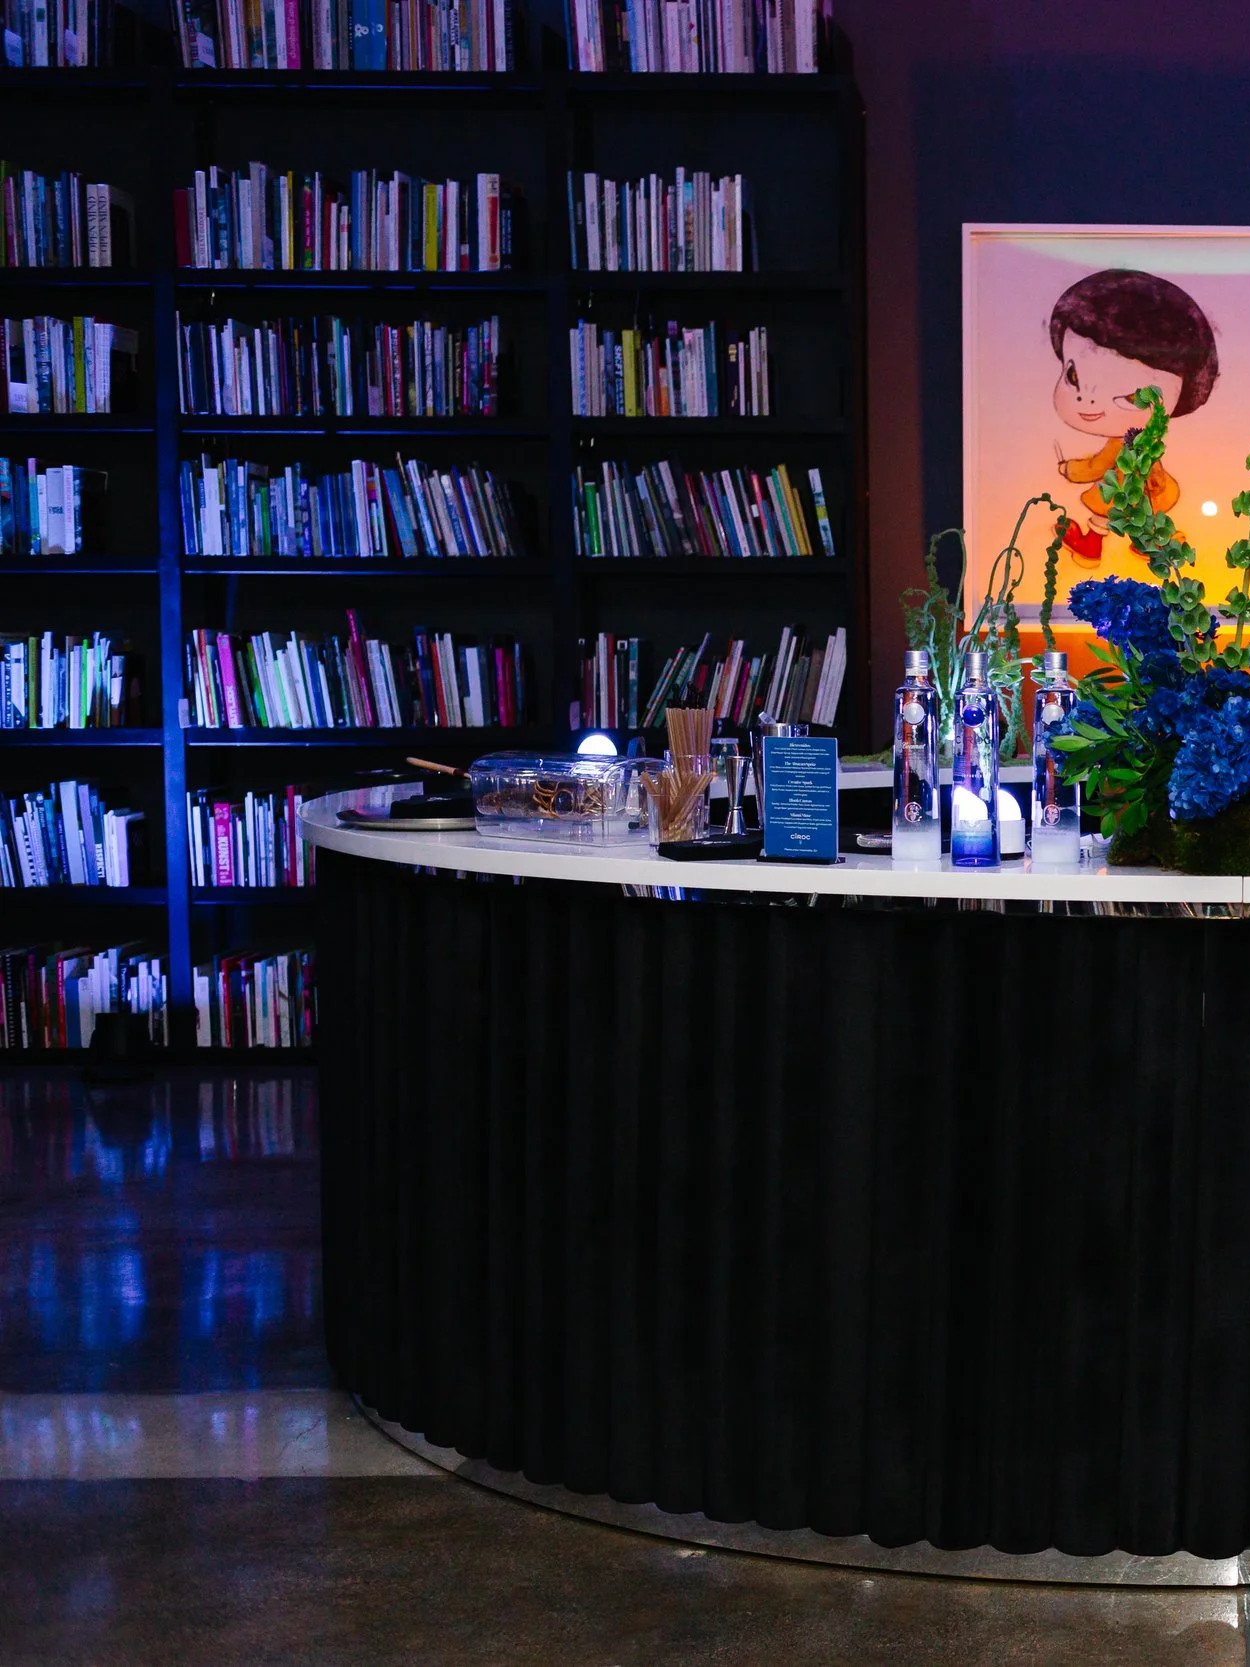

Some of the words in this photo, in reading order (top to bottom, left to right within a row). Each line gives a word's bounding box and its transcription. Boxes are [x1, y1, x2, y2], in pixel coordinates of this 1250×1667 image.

[87, 195, 96, 221] MIND
[97, 195, 107, 221] MIND
[87, 226, 97, 253] OPEN
[98, 226, 108, 253] OPEN
[95, 843, 105, 879] RESPECT!
[217, 836, 230, 872] KUNST
